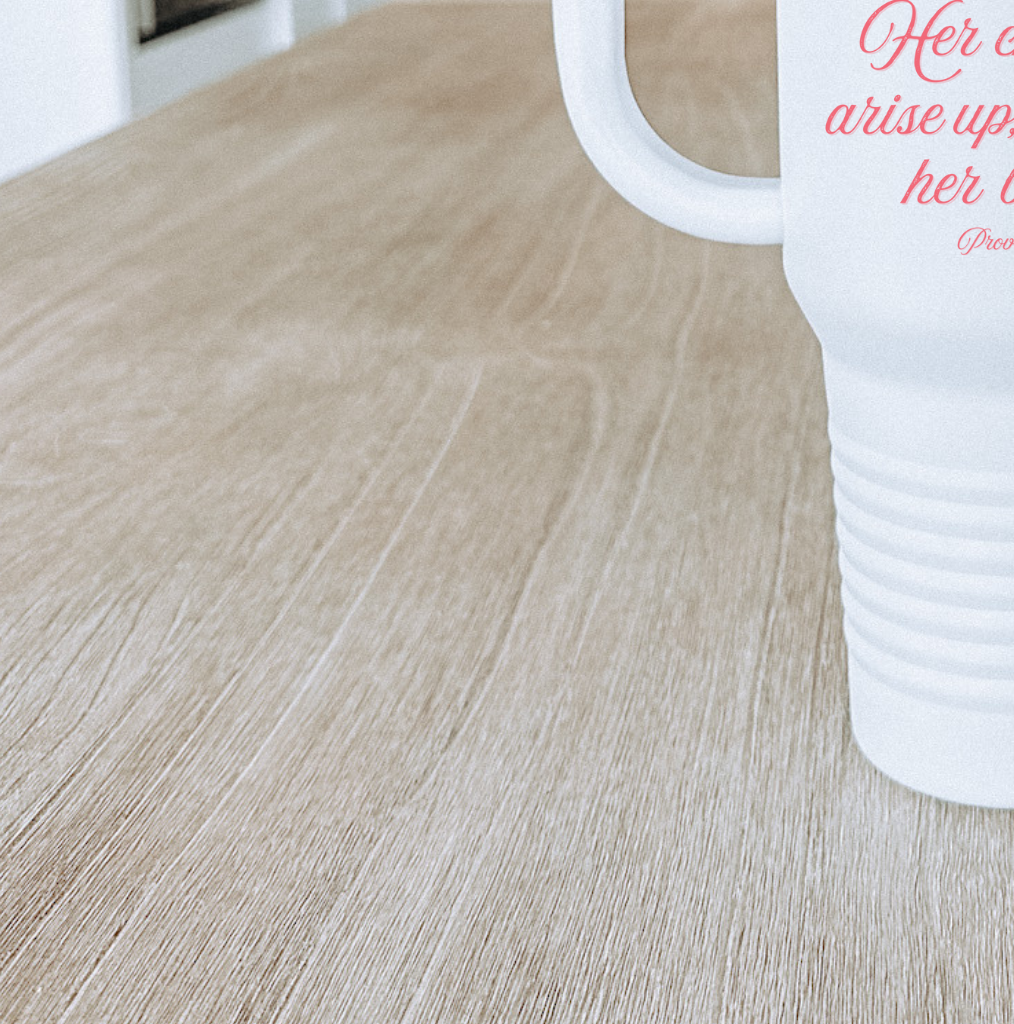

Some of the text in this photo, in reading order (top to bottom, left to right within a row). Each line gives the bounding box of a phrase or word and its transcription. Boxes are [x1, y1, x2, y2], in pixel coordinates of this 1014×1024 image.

[860, 0, 982, 83] Her
[825, 95, 946, 135] arise
[900, 159, 984, 204] her
